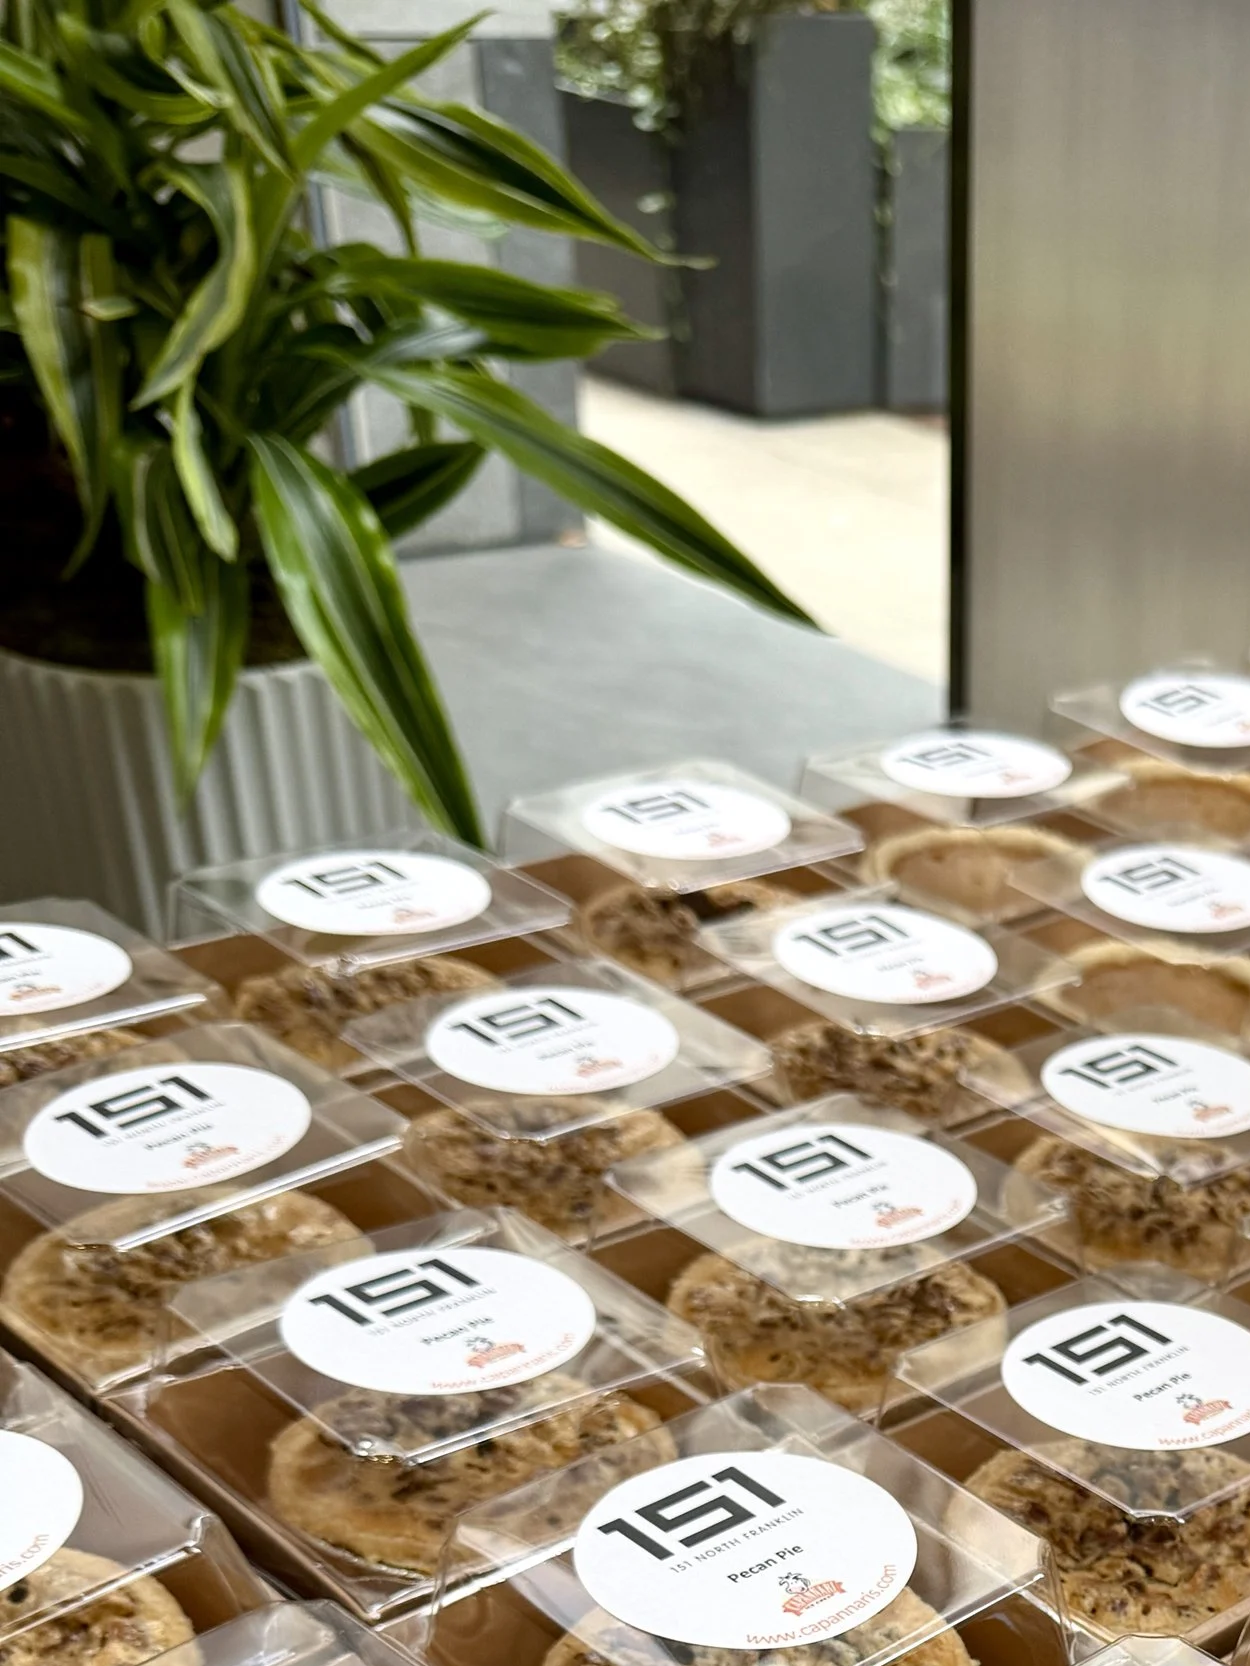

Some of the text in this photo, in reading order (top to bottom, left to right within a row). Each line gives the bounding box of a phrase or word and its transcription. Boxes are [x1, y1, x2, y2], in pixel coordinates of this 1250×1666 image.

[1024, 1315, 1170, 1384] 151
[1133, 1374, 1190, 1401] Pecan Pie
[598, 1467, 784, 1559] 151
[727, 1545, 804, 1583] Pecan Pie
[746, 1563, 897, 1645] www.capannaris.com
